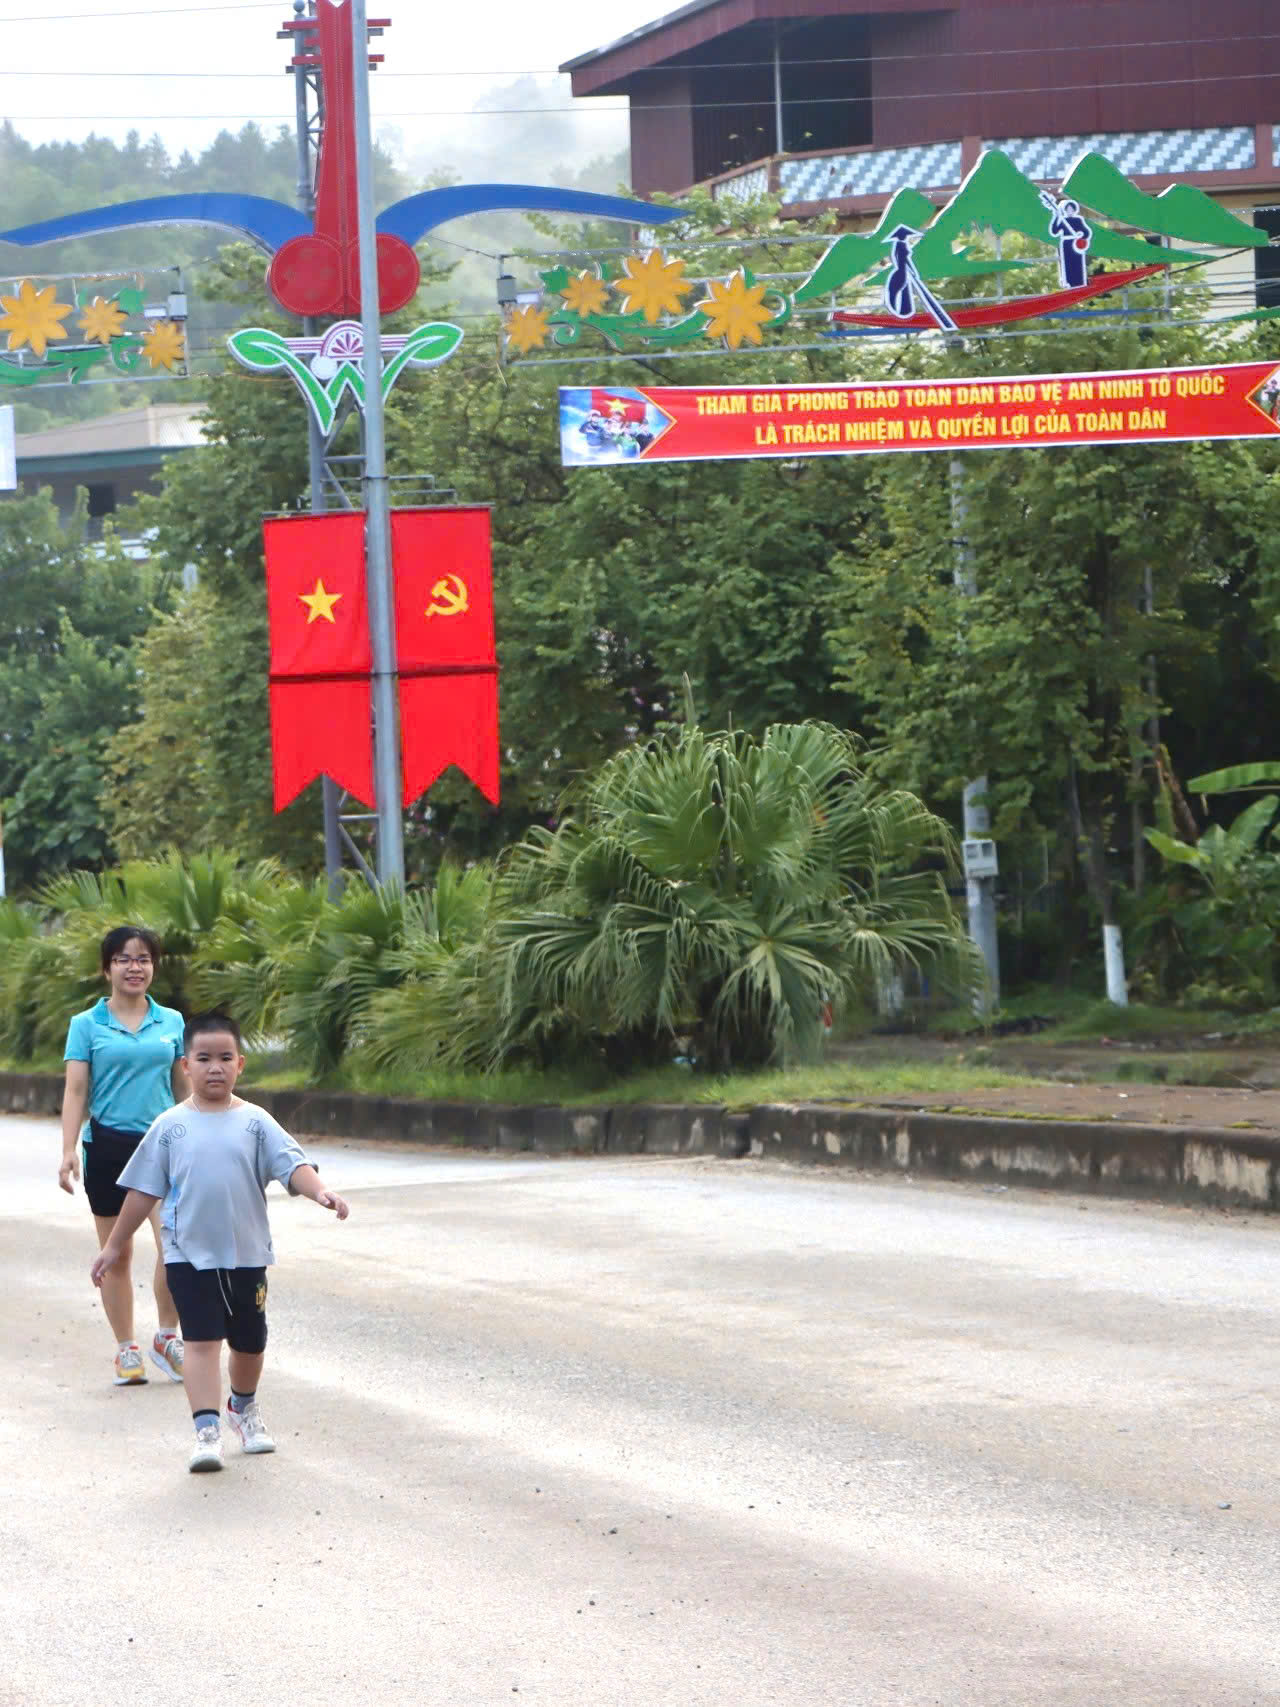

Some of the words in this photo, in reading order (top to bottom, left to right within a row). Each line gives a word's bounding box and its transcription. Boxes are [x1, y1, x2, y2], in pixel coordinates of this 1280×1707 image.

[696, 395, 747, 416] THAM
[752, 393, 783, 414] GIA
[787, 391, 849, 412] PHONG
[853, 387, 900, 409] TRÀO
[904, 385, 952, 407] TOÀN
[1068, 381, 1094, 400] AN
[1098, 379, 1144, 399] NINH
[1176, 370, 1225, 399] QUỐC
[755, 422, 778, 445] LÀ
[782, 420, 841, 444] TRÁCH
[845, 417, 904, 444] NHIỆM
[908, 416, 933, 439] VÀ
[1001, 414, 1030, 439] LỢI
[1035, 408, 1072, 433] CỦA
[1076, 408, 1124, 432] TOÀN
[1128, 407, 1167, 431] DÂN
